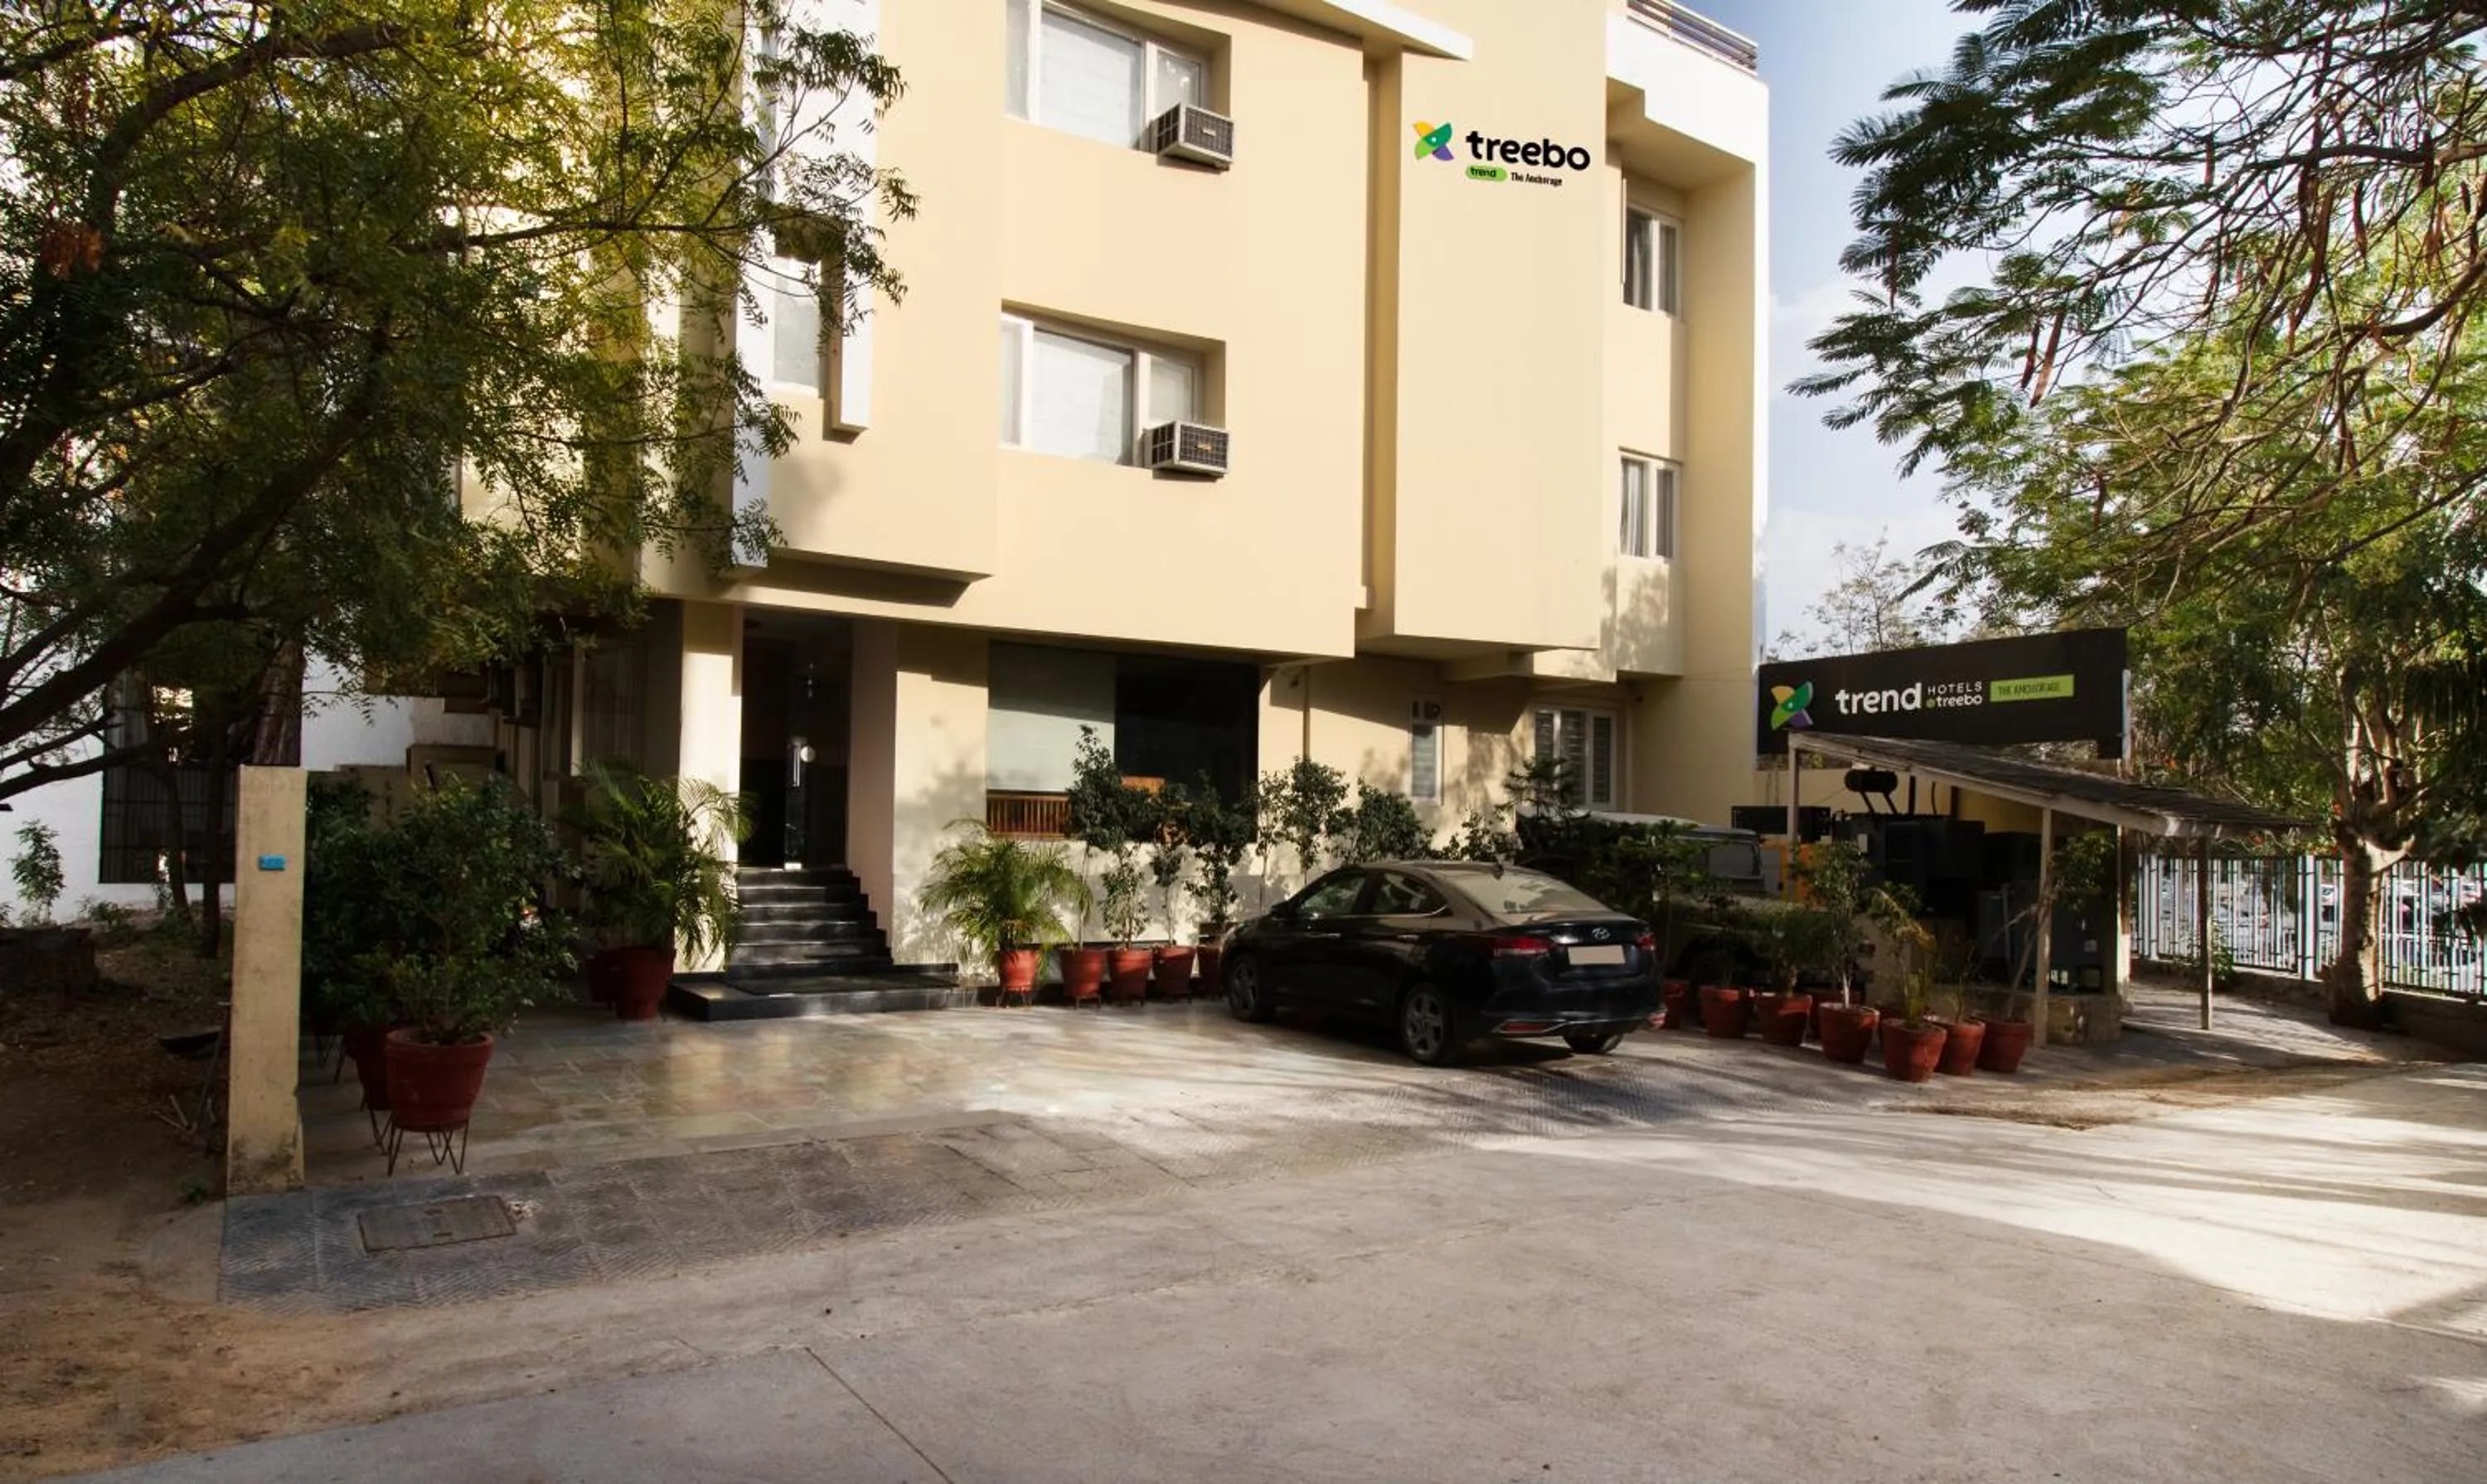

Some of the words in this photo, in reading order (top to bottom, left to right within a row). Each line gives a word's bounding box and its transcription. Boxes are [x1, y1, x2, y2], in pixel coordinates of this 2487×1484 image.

[1466, 131, 1590, 170] treebo
[1470, 166, 1496, 177] trend
[1511, 172, 1524, 182] The
[1927, 681, 1983, 696] HOTELS
[1835, 682, 1922, 715] trend
[1936, 694, 1983, 707] treebo
